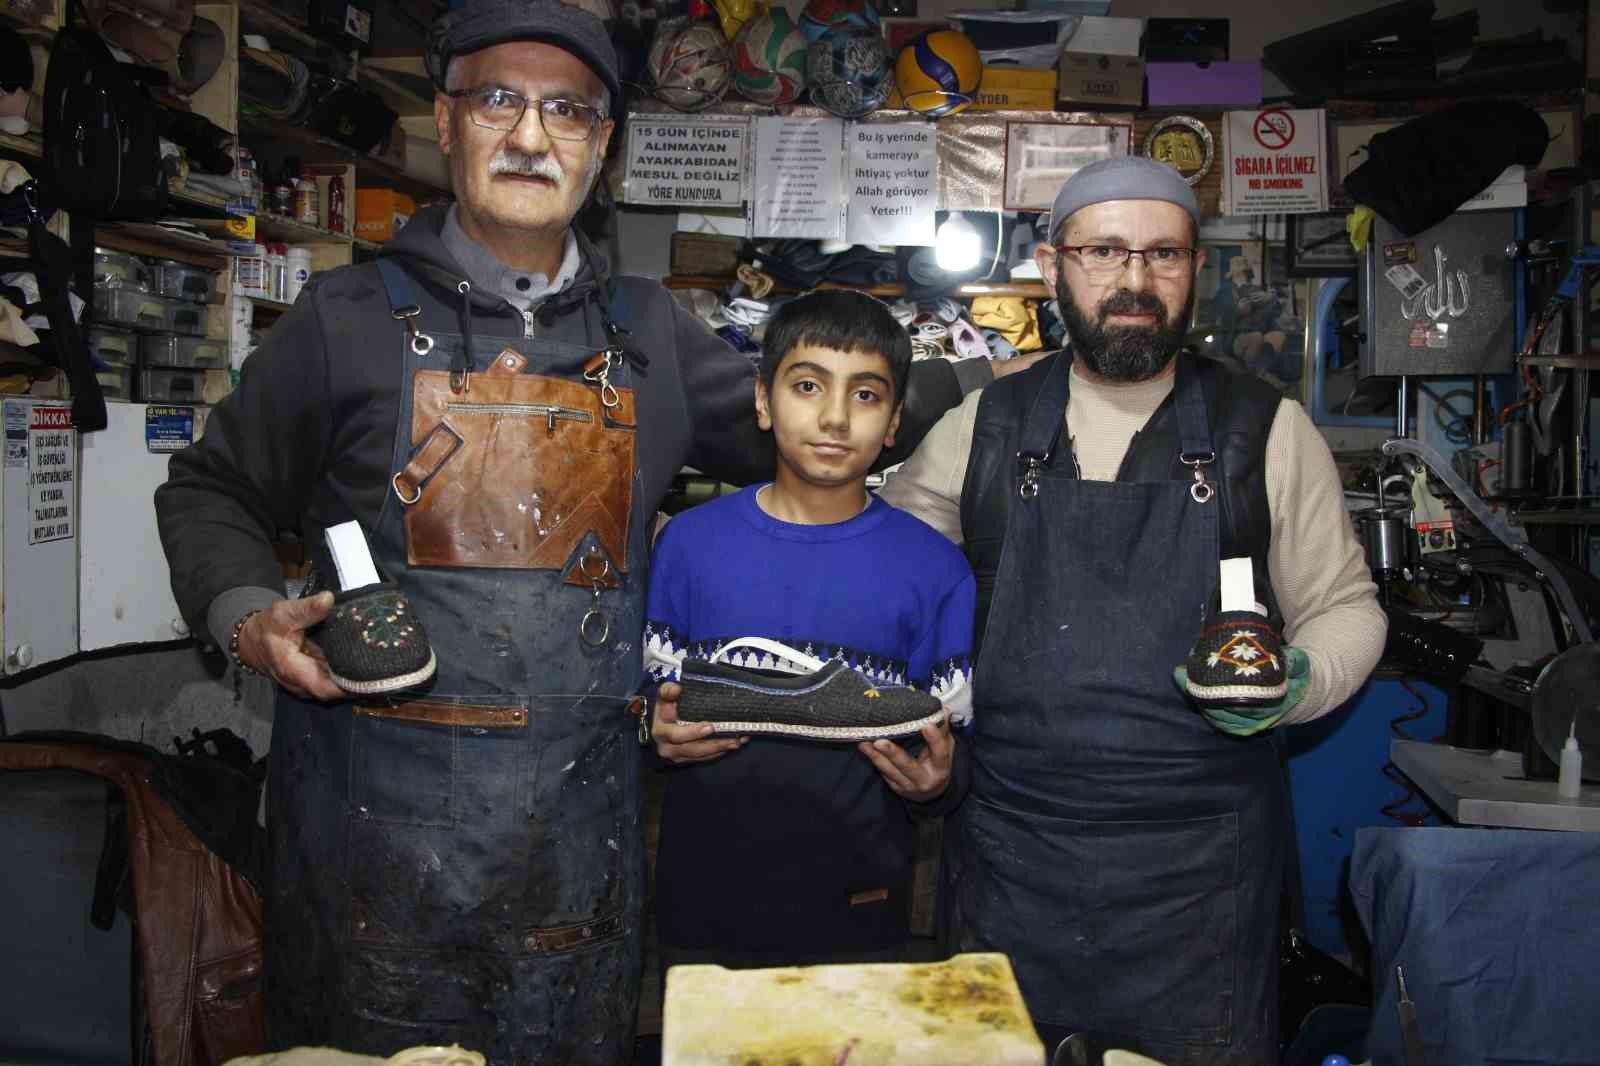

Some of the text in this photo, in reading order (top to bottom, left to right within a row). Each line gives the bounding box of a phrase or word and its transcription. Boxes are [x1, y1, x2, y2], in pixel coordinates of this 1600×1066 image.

[636, 126, 741, 139] 15 GÜN İÇİNDE
[858, 132, 928, 144] Bu iş yerinde
[643, 142, 727, 153] ALINMAYAN
[636, 156, 737, 167] AYAKKABIDAN
[865, 150, 920, 162] kameraya
[1235, 152, 1316, 176] SİGARA İÇİLMEZ
[631, 170, 741, 182] MESUL DEĞİLİZ
[855, 167, 929, 179] ihtiyaç yoktur
[1248, 178, 1304, 189] NO SMOKING
[647, 185, 722, 201] YÖRE KUNDURA
[855, 185, 929, 199] Allah görüyor
[871, 206, 911, 216] Yeter!!!
